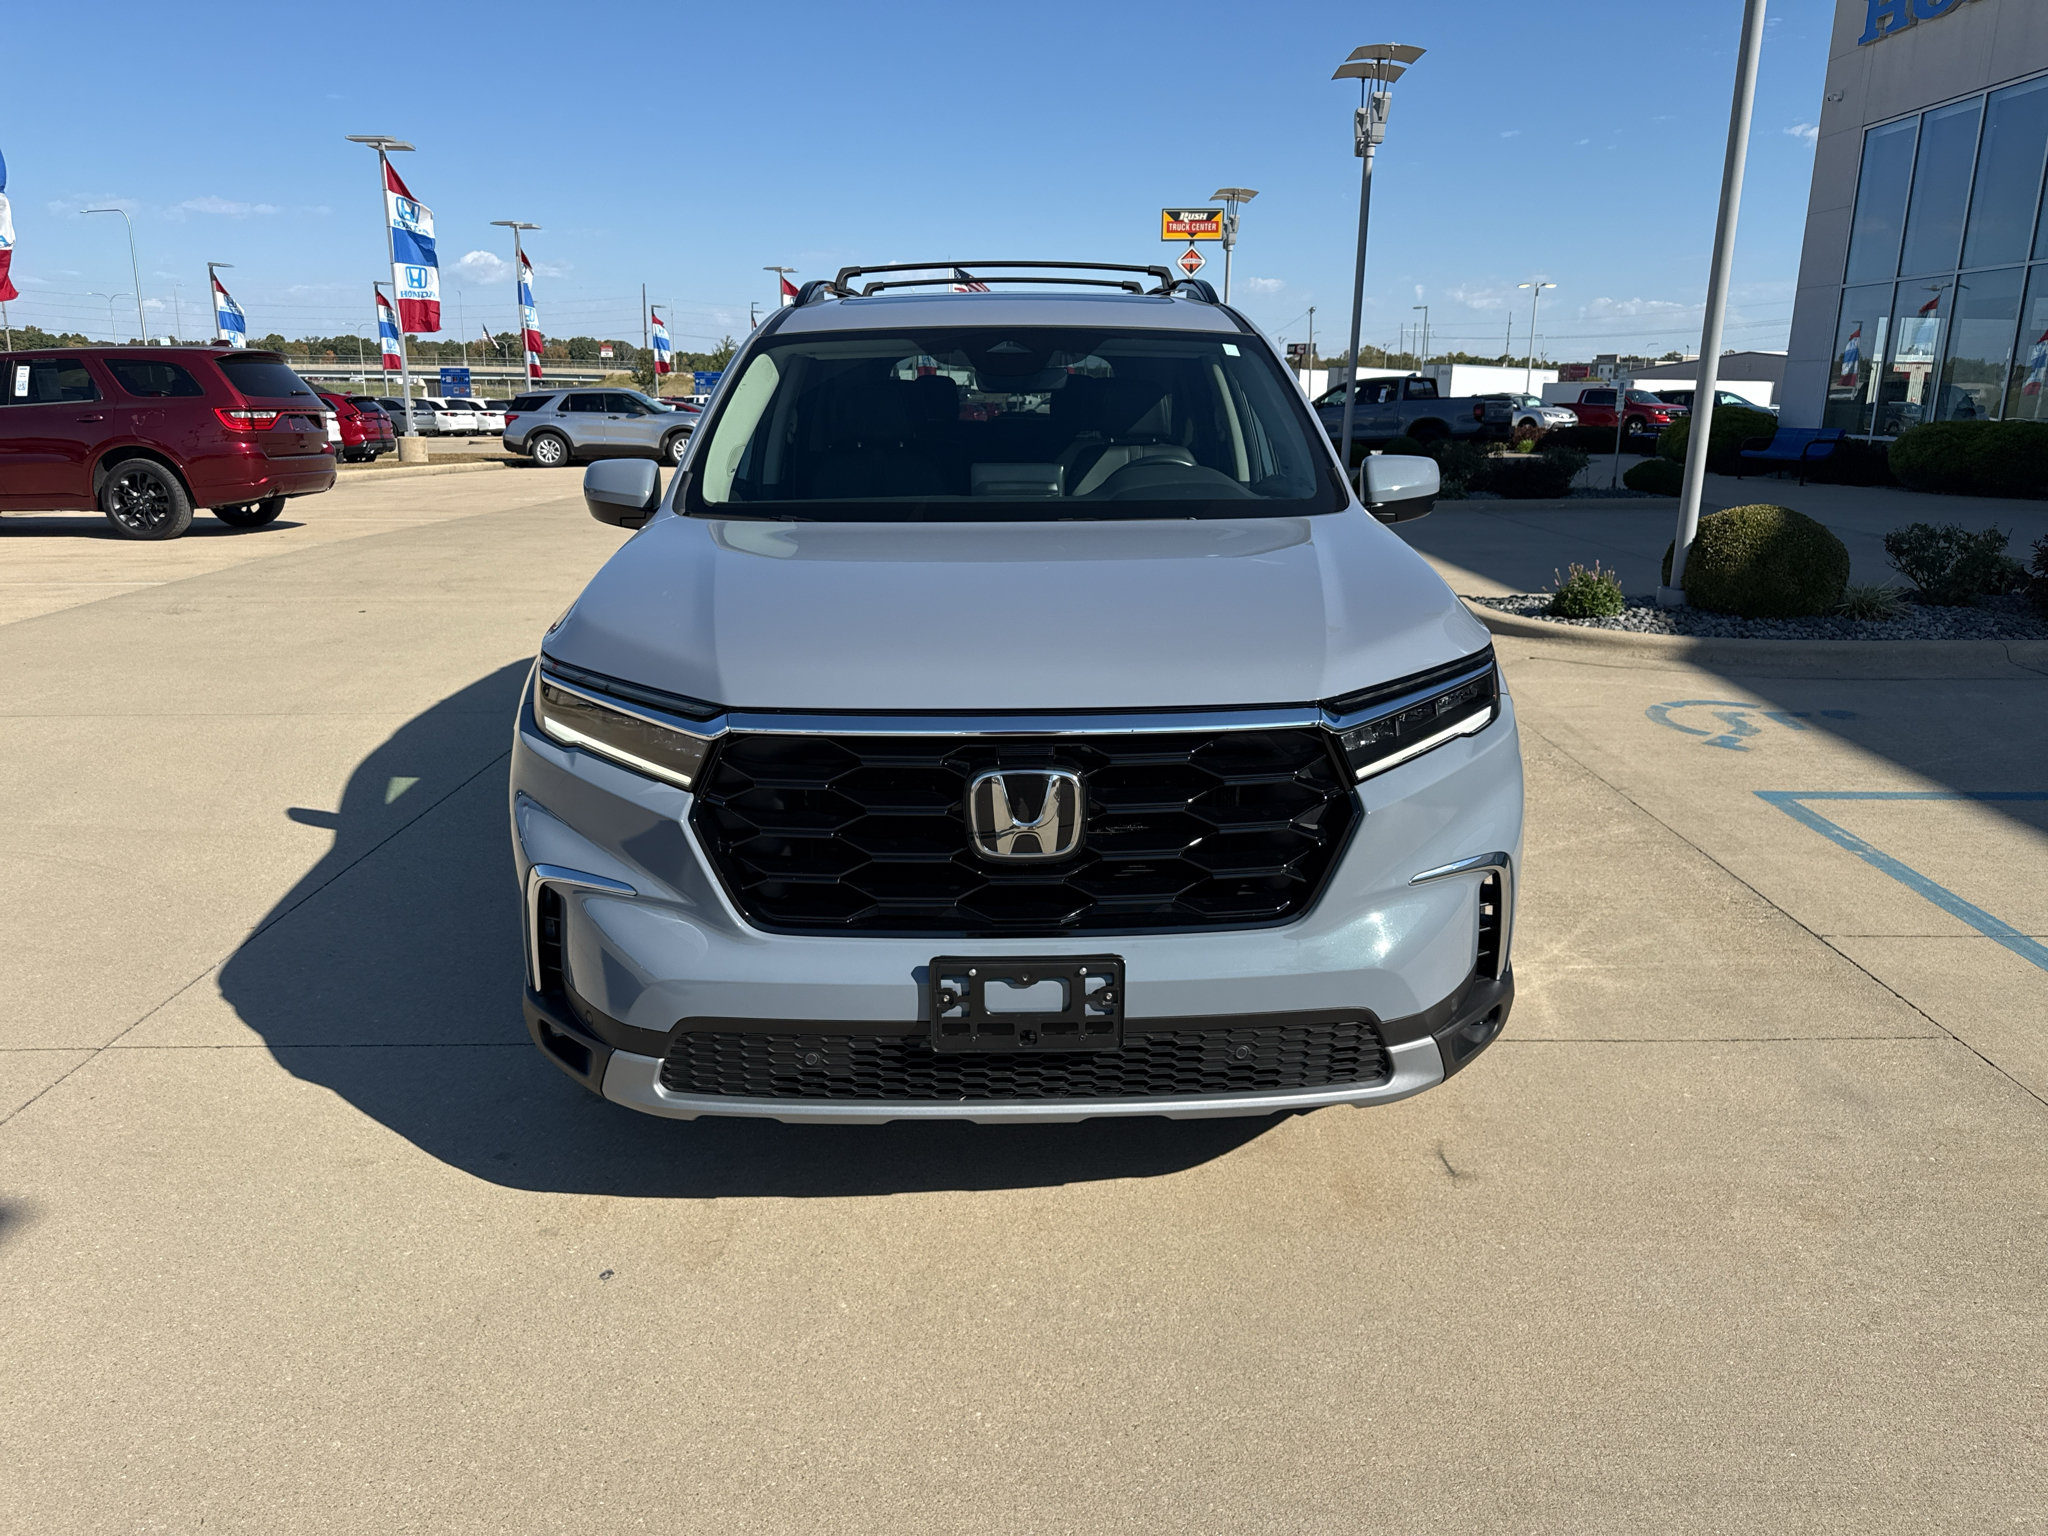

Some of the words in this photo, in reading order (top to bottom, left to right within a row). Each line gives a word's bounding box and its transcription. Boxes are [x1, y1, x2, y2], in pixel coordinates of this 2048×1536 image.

[1169, 223, 1190, 231] TRUCK
[1191, 223, 1217, 231] CENTER
[400, 290, 436, 298] HONDA
